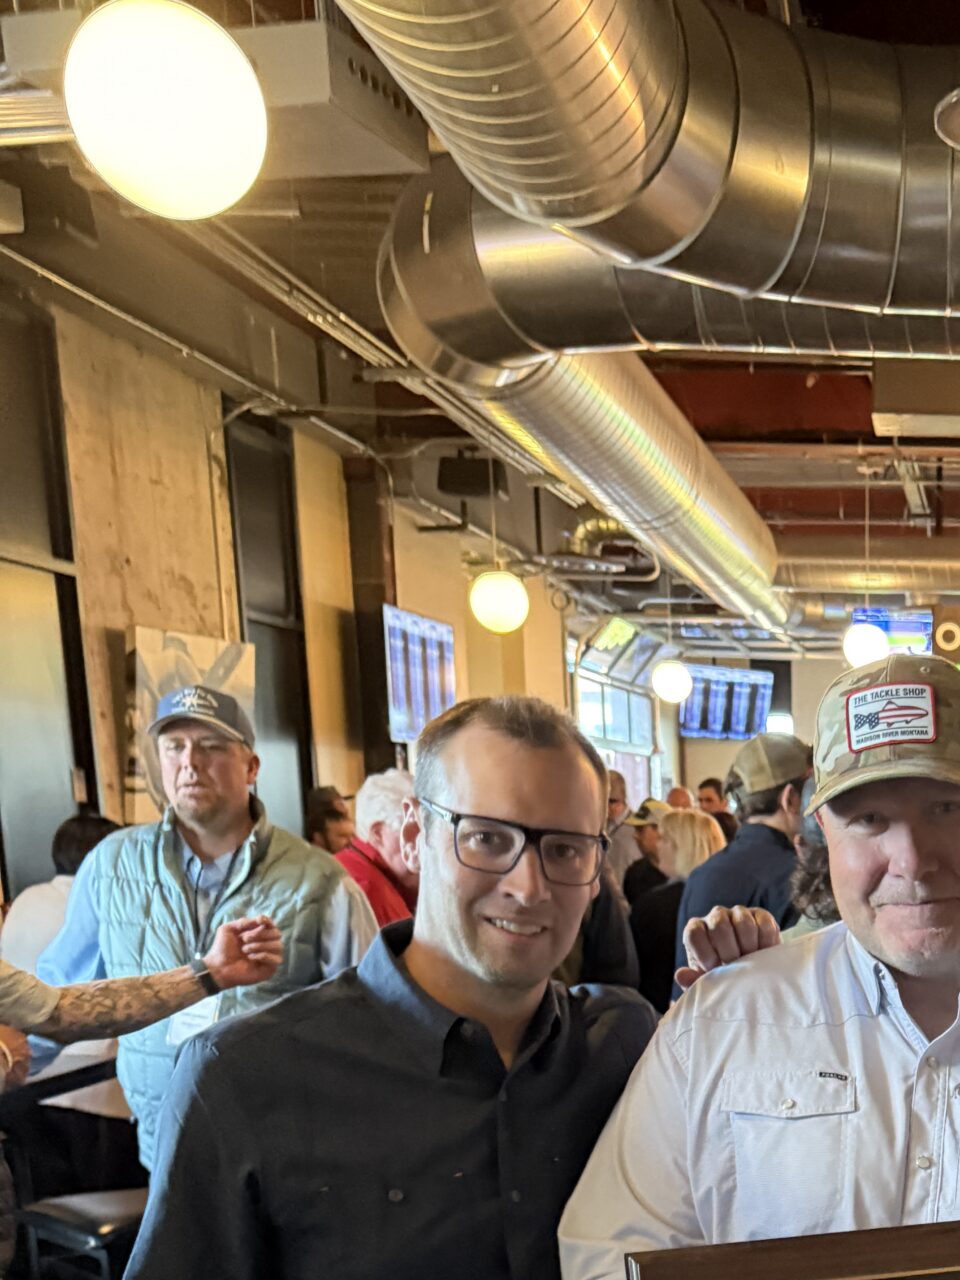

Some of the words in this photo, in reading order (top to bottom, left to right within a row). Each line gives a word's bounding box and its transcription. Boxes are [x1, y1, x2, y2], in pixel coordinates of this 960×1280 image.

[854, 694, 868, 705] THE
[871, 688, 900, 700] TACKLE
[903, 688, 926, 696] SHOP
